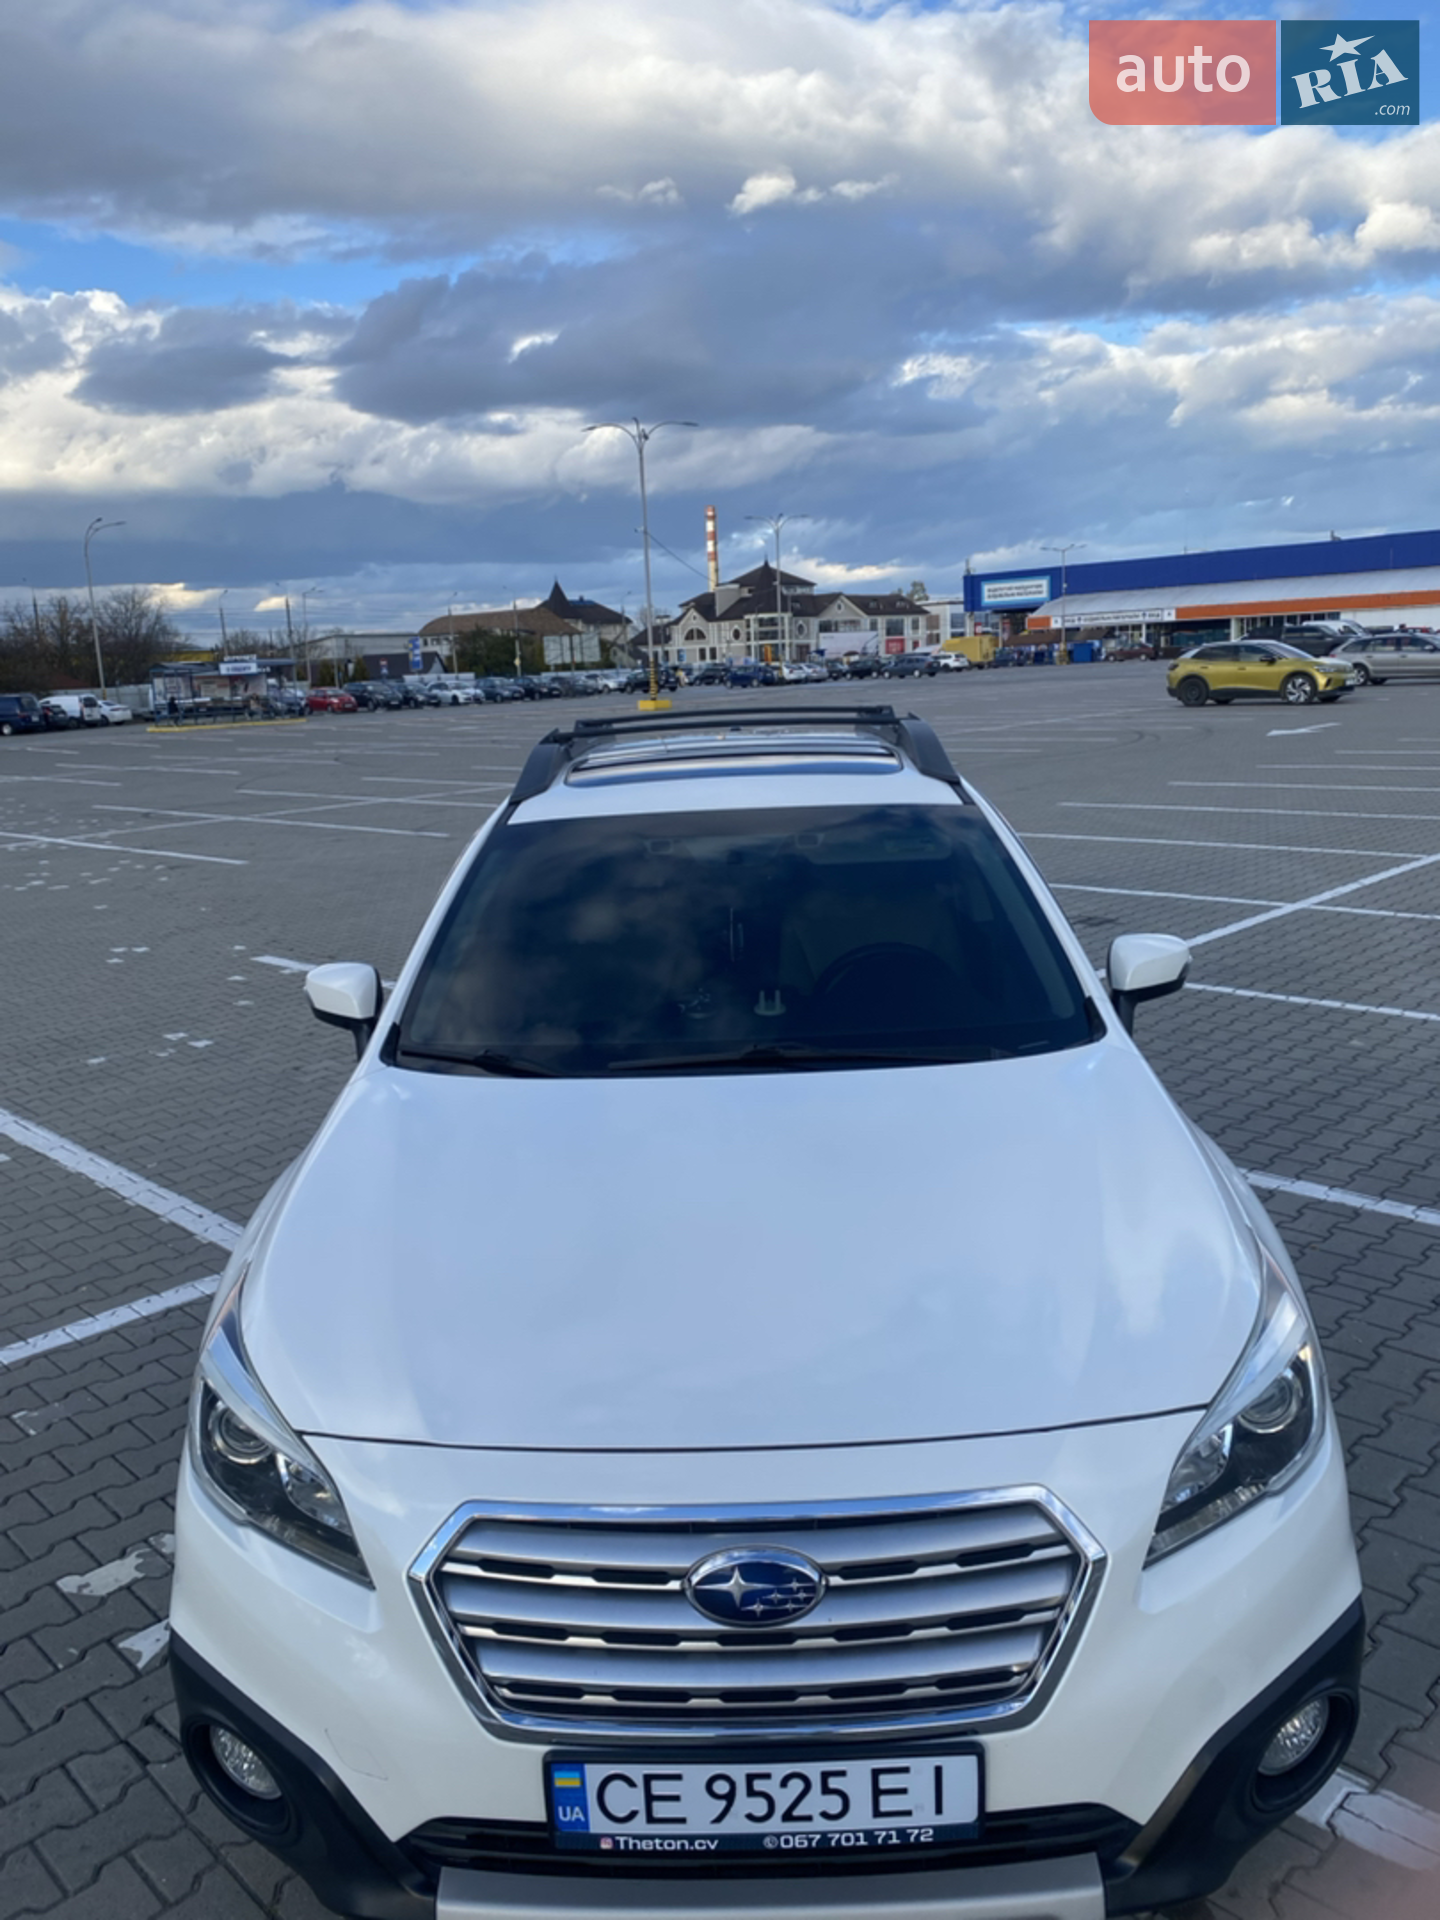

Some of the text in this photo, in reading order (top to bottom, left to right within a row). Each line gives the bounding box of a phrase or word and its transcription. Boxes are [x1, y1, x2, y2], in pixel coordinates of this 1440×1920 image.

[596, 1772, 687, 1825] CE
[705, 1769, 850, 1824] 9525
[557, 1806, 586, 1822] UA
[615, 1836, 719, 1851] Theton.cv
[779, 1828, 934, 1849] 067 701 71 72
